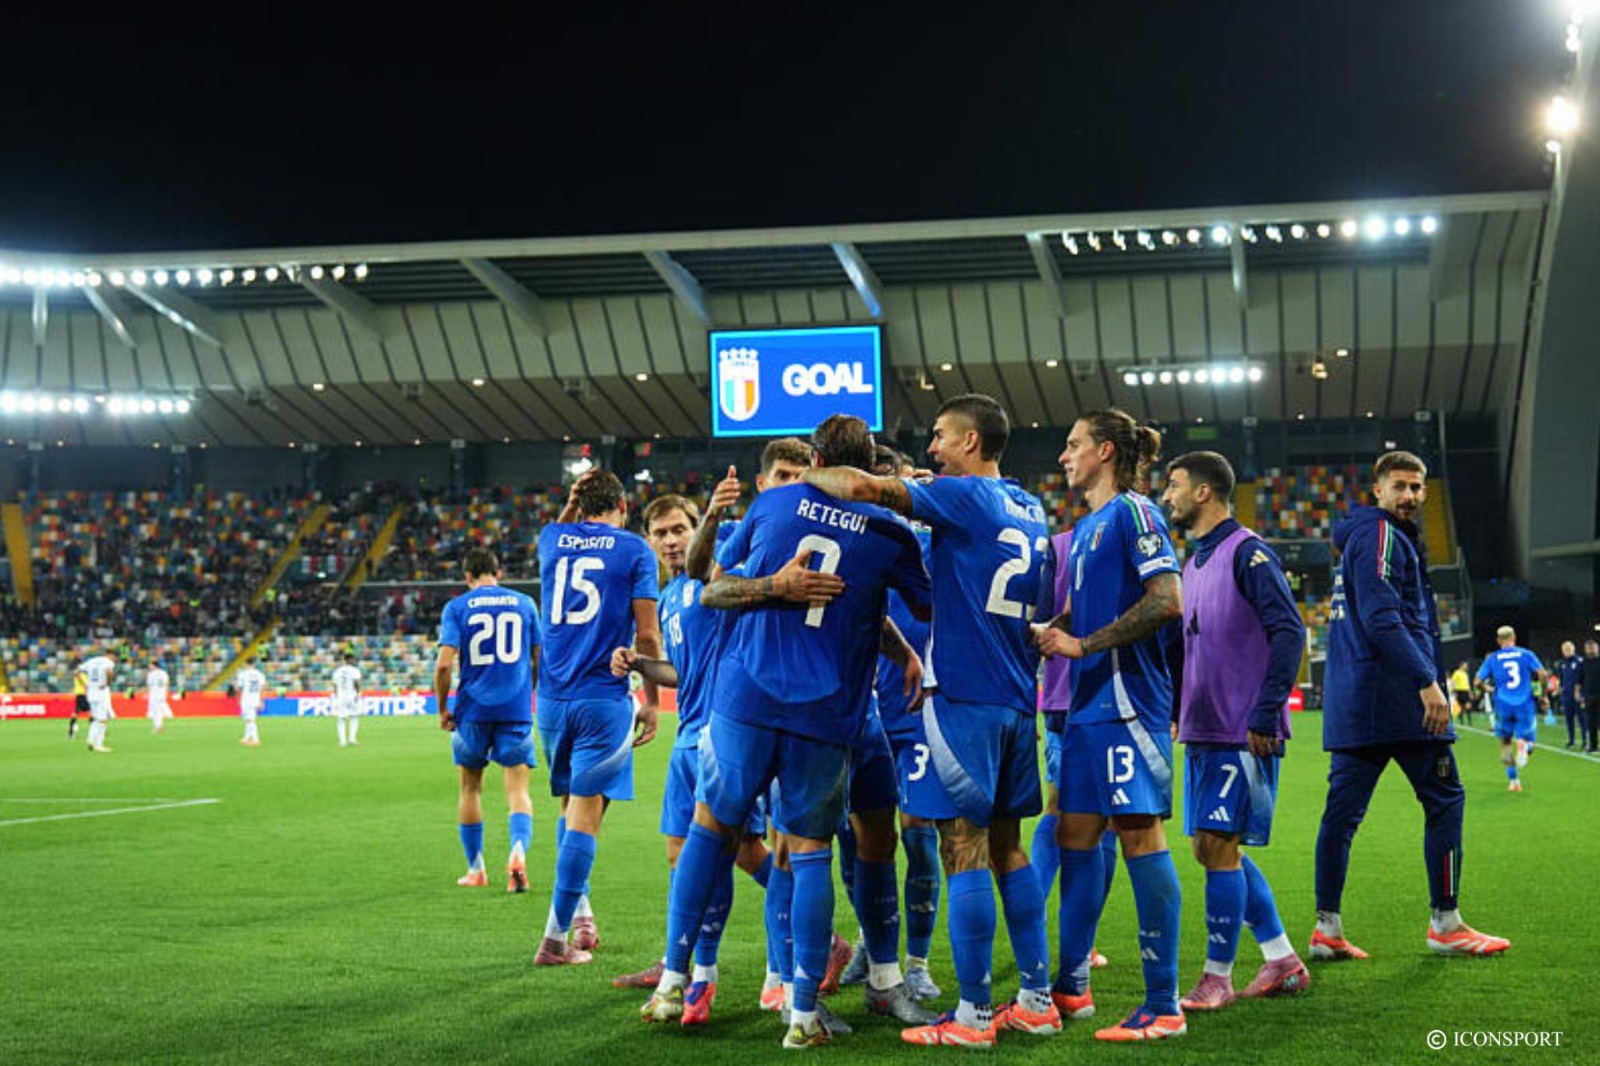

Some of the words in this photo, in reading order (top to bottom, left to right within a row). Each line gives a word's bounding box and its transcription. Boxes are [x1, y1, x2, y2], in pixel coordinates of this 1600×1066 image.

[782, 362, 873, 396] GOAL
[797, 498, 868, 535] RETEGUI
[551, 556, 605, 625] 15
[796, 534, 841, 628] 9
[468, 612, 523, 666] 20
[1503, 660, 1521, 690] 3
[297, 696, 427, 717] PRATOR
[908, 743, 930, 781] 3
[1107, 745, 1135, 784] 13
[1218, 764, 1239, 799] 7
